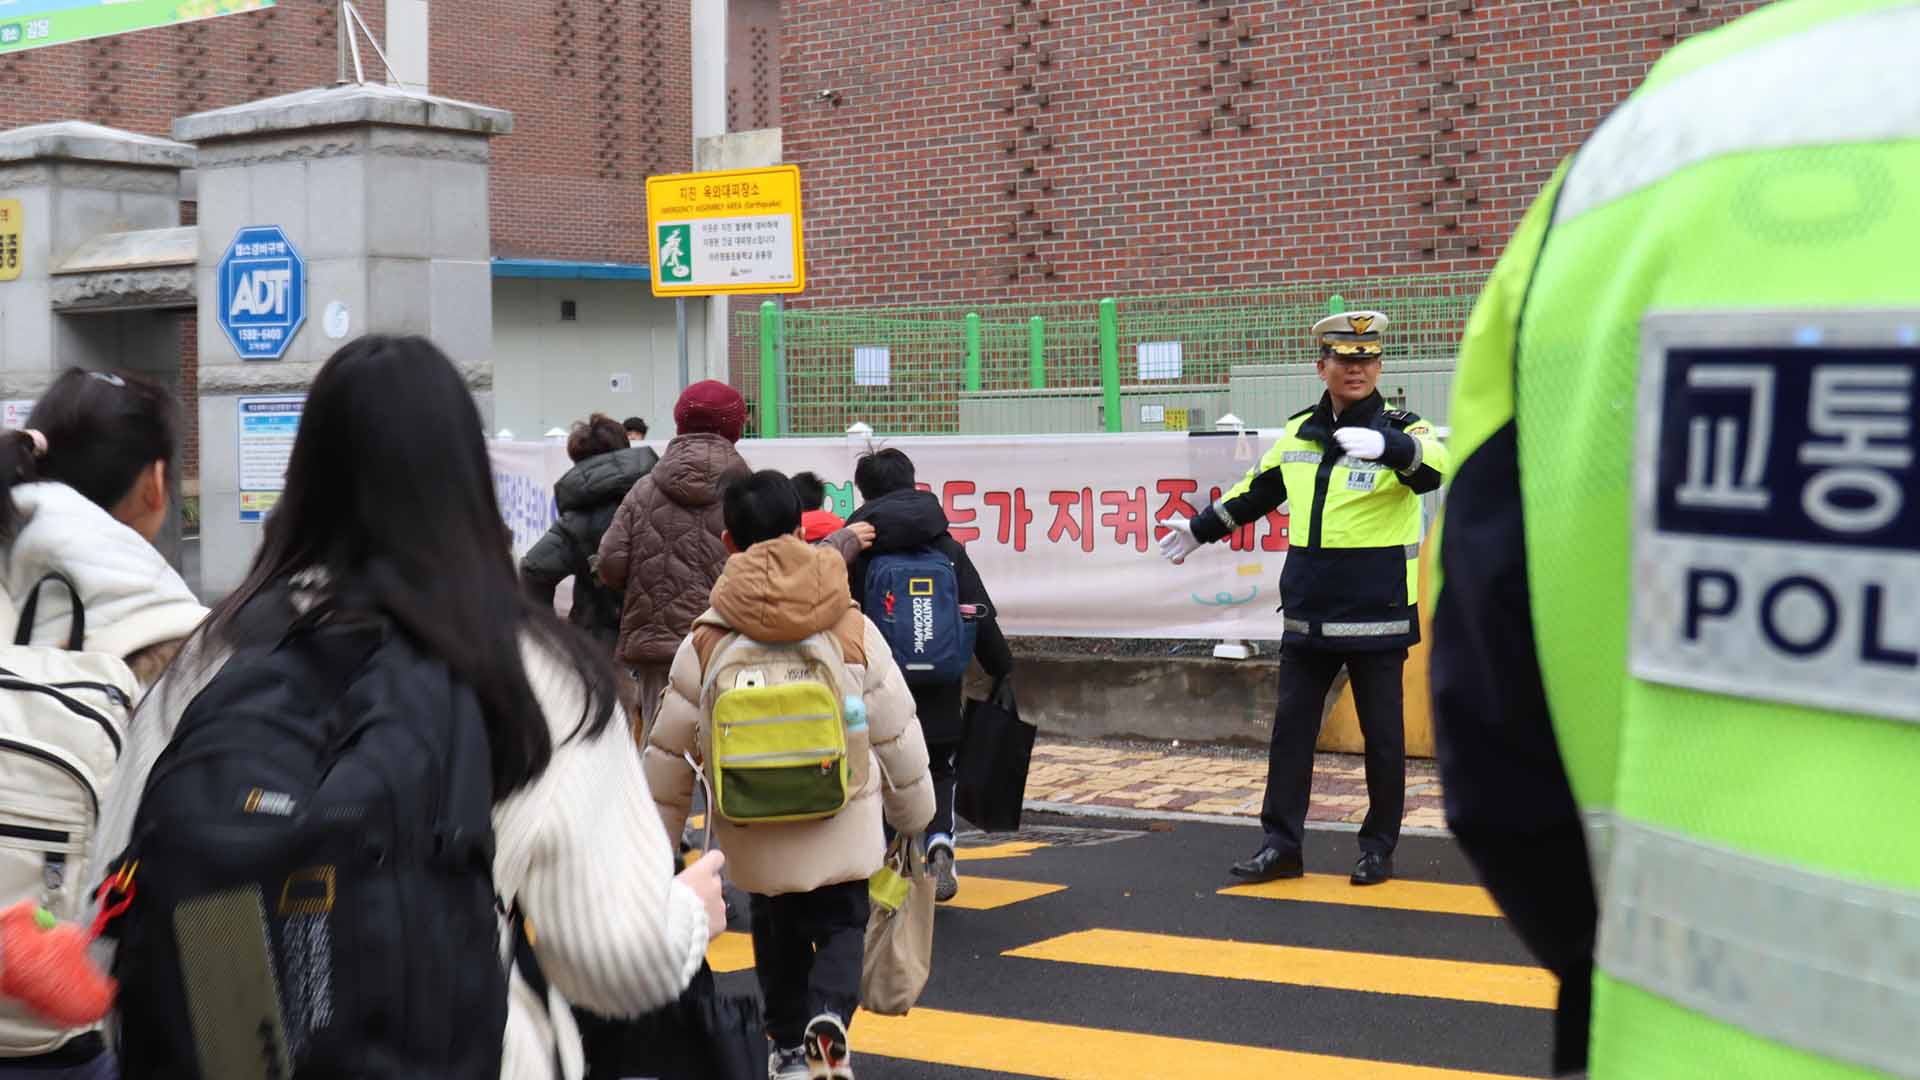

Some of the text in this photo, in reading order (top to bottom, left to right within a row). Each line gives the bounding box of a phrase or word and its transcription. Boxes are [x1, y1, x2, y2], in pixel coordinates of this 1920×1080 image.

[680, 183, 760, 203] 지진 옥외대피장소
[230, 269, 289, 316] ADT
[1675, 363, 1914, 534] 교통
[914, 479, 1033, 553] 두가
[912, 597, 924, 655] GEOGRAPHIC
[921, 597, 934, 642] NATIONAL
[1682, 568, 1918, 666] POL
